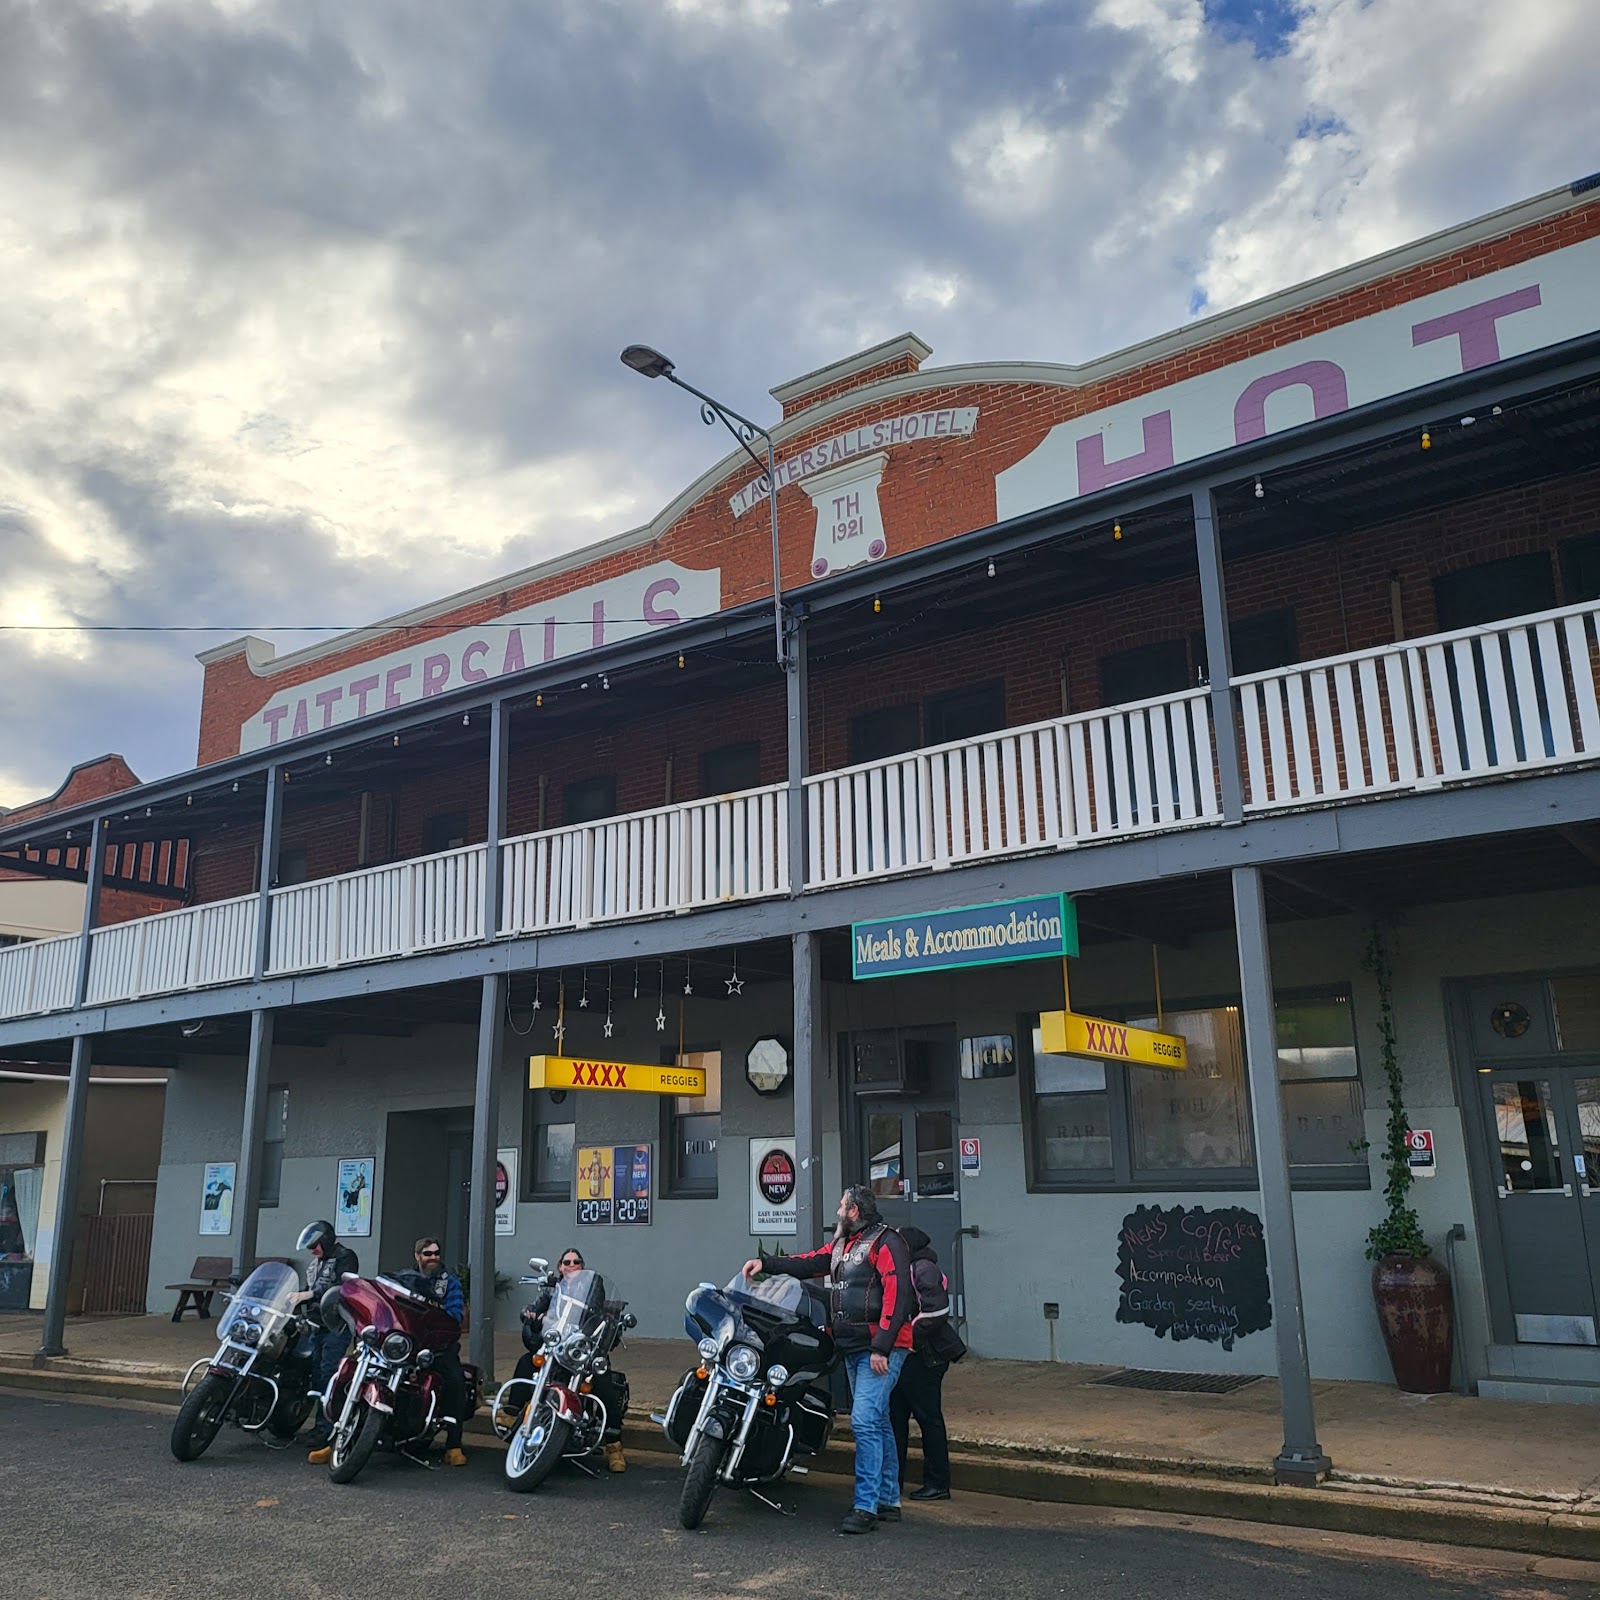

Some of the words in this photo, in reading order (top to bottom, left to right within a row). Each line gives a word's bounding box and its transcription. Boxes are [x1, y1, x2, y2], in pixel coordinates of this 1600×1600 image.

[738, 424, 885, 509] TATERSALLS
[832, 492, 860, 520] TH
[832, 516, 864, 543] 1921
[856, 928, 901, 964] Meals
[904, 927, 920, 957] &
[923, 910, 1062, 955] Accommodation
[1084, 1020, 1129, 1056] XXXX
[1153, 1041, 1182, 1058] REGGIES
[572, 1062, 627, 1087] XXXX
[660, 1075, 698, 1087] REGGIES
[632, 1171, 647, 1179] NEW
[763, 1173, 791, 1182] TOOHEYS
[768, 1185, 787, 1193] NEW
[1180, 1215, 1242, 1259] Coffee
[1128, 1289, 1176, 1316] Garden
[1185, 1295, 1239, 1328] seating
